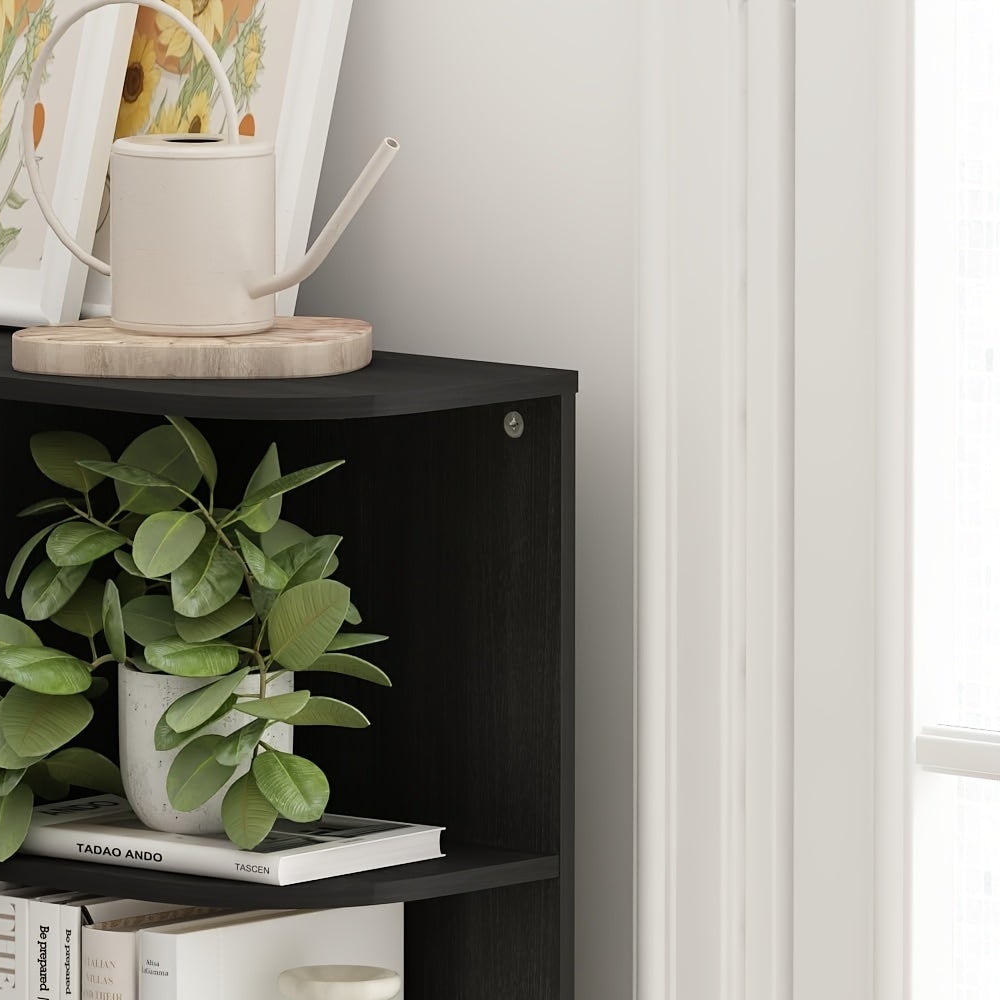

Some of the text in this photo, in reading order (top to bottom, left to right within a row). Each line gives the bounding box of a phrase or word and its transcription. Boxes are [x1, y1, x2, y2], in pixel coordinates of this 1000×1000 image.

[76, 843, 163, 863] TADAO ANDO
[234, 863, 270, 875] TASCEN
[39, 925, 50, 940] Be
[65, 928, 72, 943] Be
[37, 941, 50, 992] prepared
[64, 944, 72, 995] prepared
